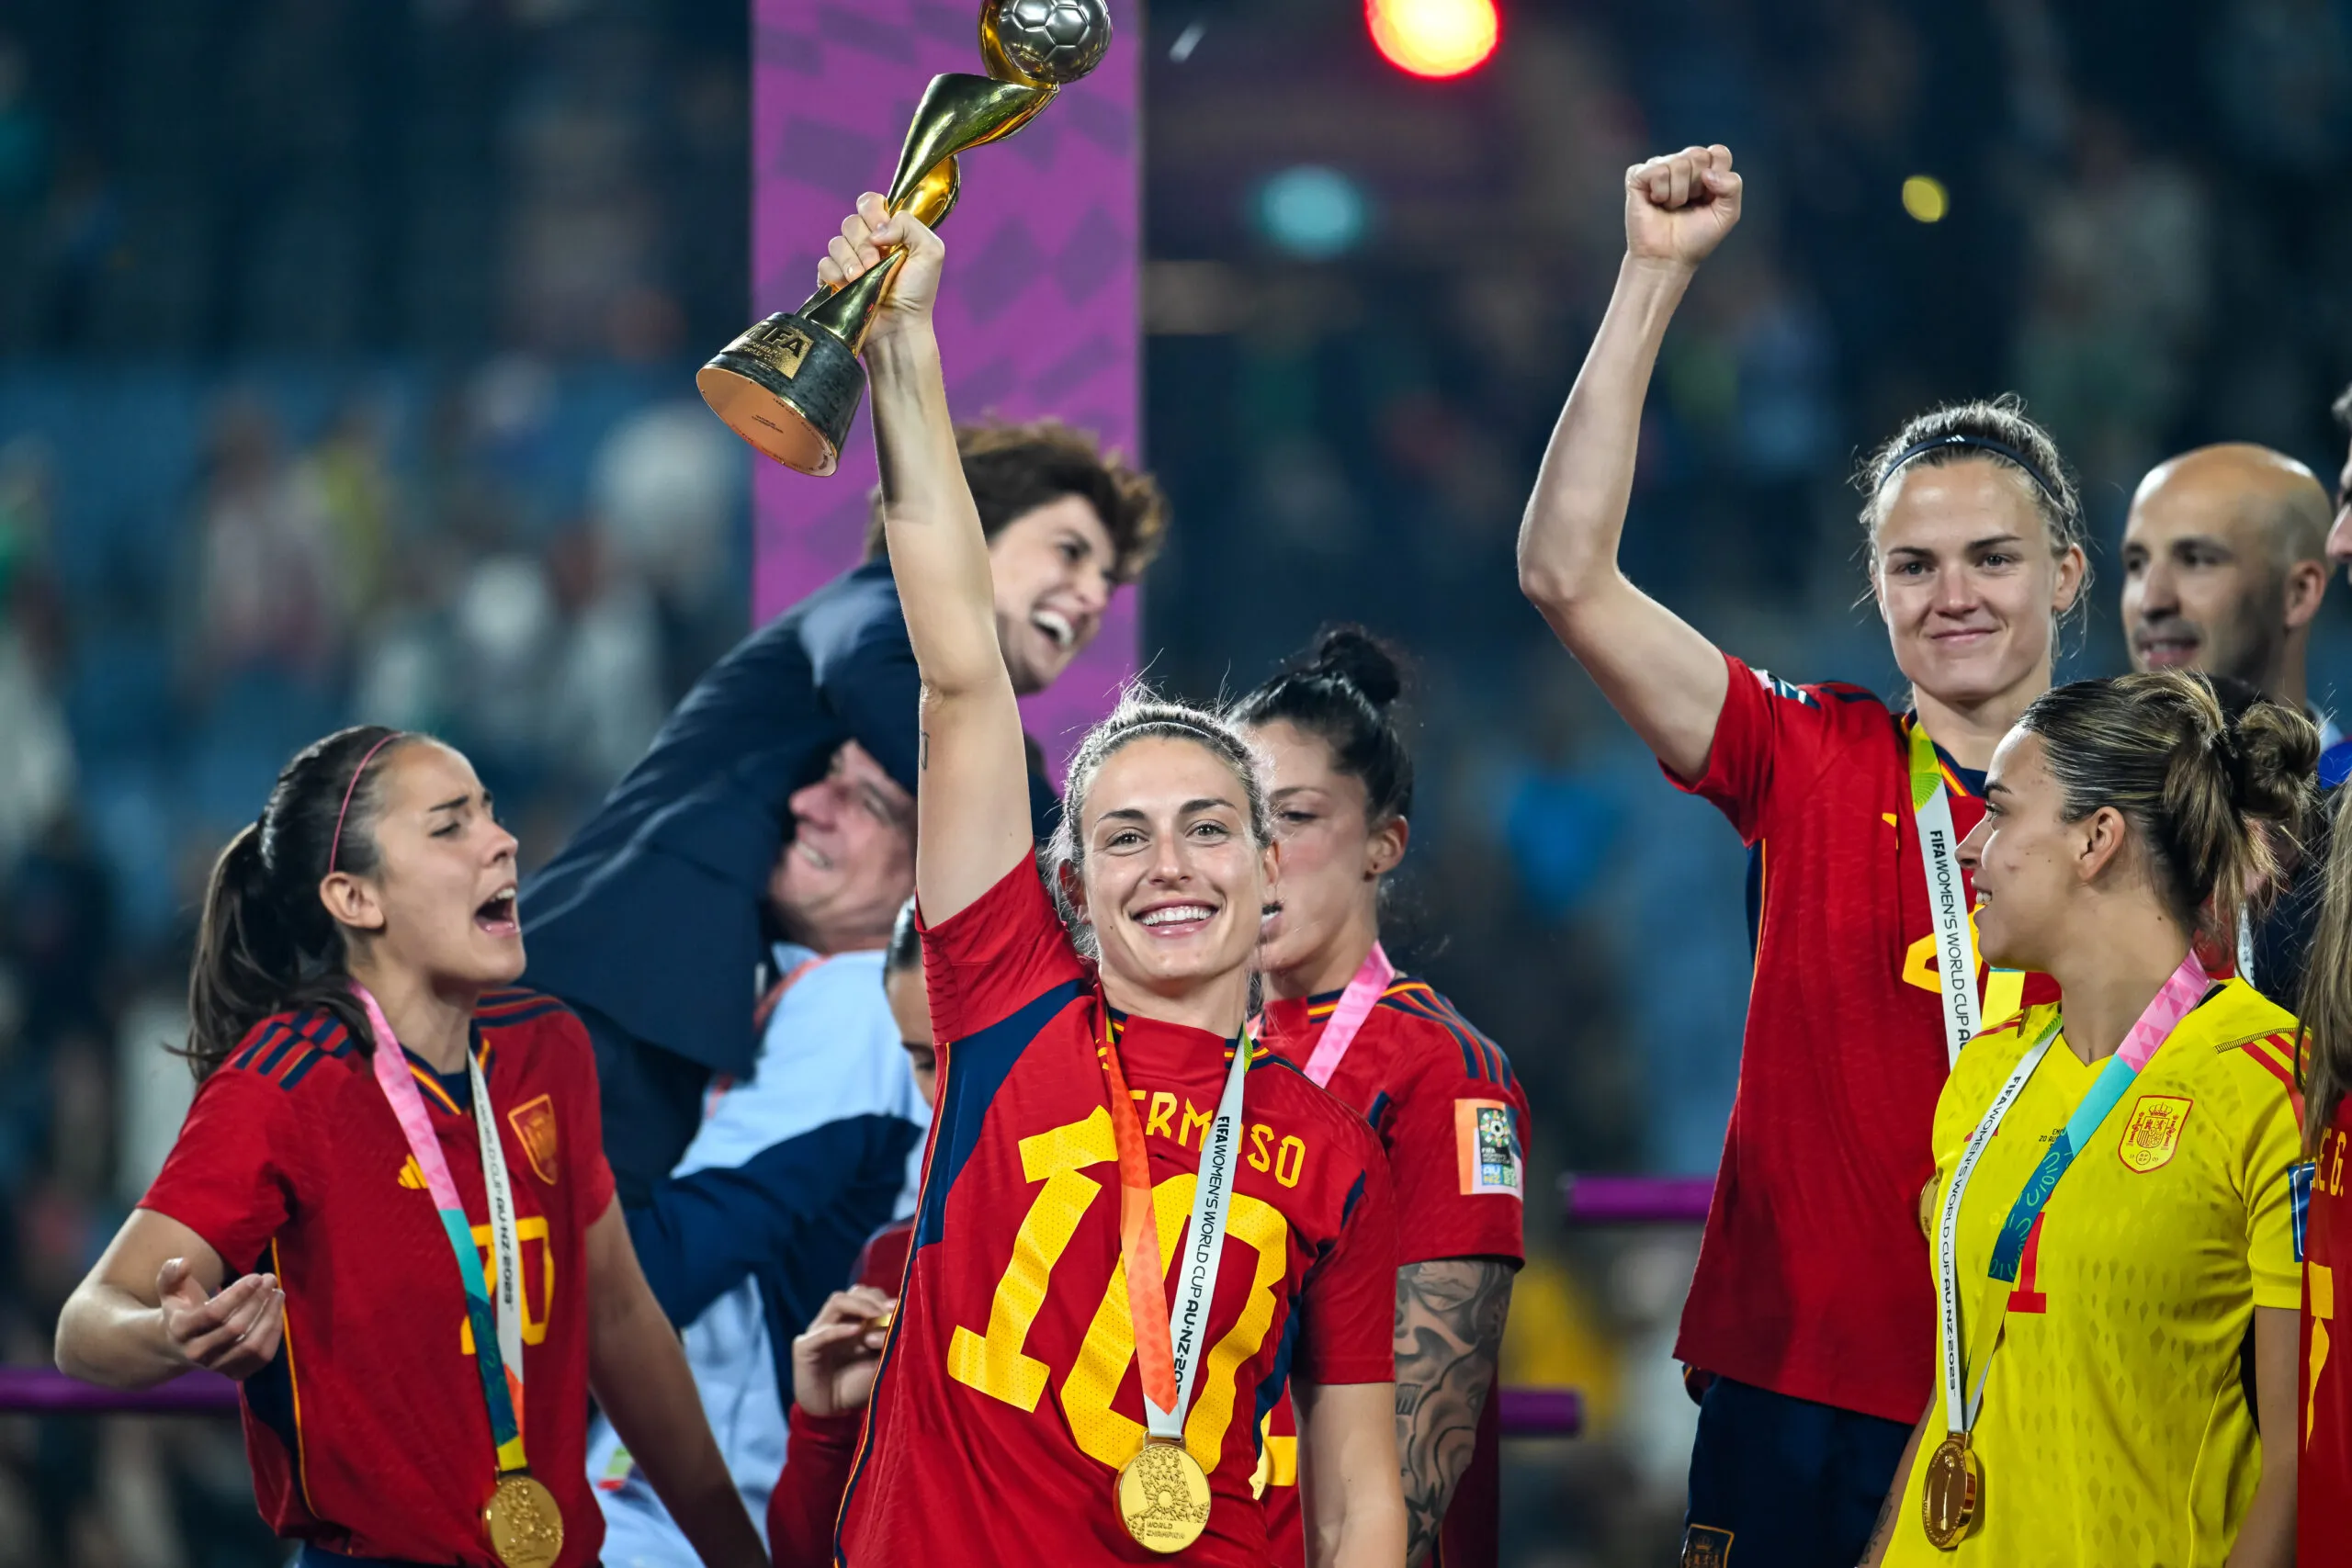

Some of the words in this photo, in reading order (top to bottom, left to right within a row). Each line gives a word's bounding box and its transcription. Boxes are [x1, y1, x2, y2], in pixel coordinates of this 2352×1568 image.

[1929, 829, 1946, 859] FIFA
[1935, 859, 1958, 930] WOMEN'S
[1947, 932, 1965, 990] WORLD
[1954, 993, 1969, 1026] CUP
[1996, 1076, 2021, 1105] FIFA
[1216, 1116, 1230, 1144] FIFA
[1958, 1106, 2002, 1177] WOMEN'S
[1205, 1145, 1227, 1209] WOMEN'S
[1942, 1179, 1963, 1238] WORLD
[1196, 1211, 1216, 1263] WORLD
[1942, 1241, 1951, 1275] CUP
[947, 1104, 1287, 1475] 10
[1190, 1265, 1205, 1298] CUP
[1146, 1521, 1173, 1529] WORLD
